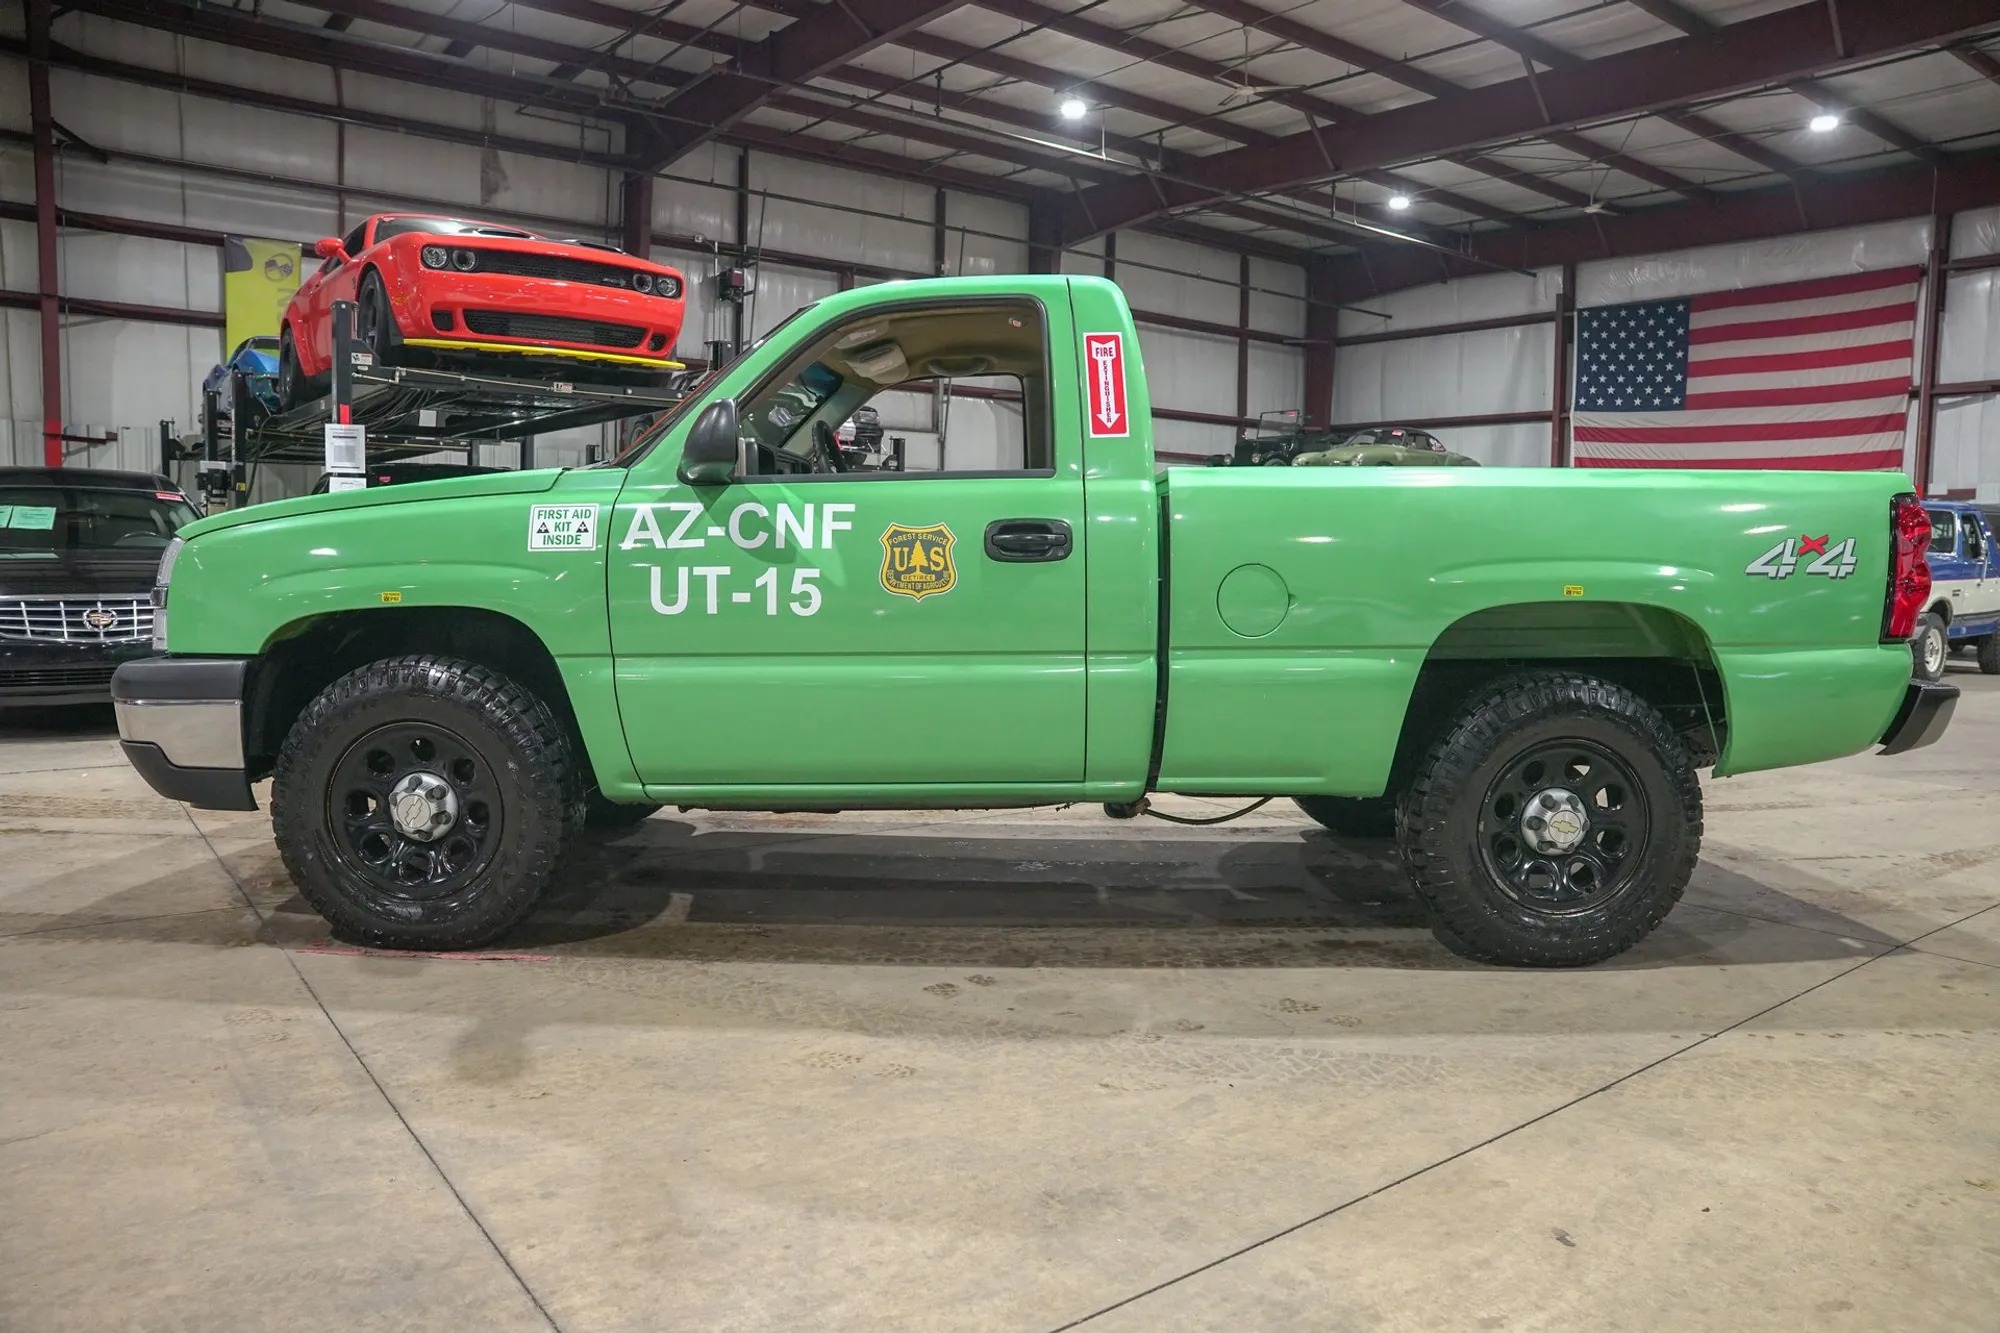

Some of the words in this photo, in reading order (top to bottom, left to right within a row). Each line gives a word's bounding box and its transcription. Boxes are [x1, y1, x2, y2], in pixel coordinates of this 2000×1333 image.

[1095, 347, 1114, 357] FIRE
[1102, 360, 1112, 423] EXTINGUISHER
[537, 509, 569, 520] FIRST
[571, 509, 592, 519] AID
[554, 521, 572, 532] KIT
[620, 502, 856, 550] AZ-CNF
[542, 534, 582, 545] INSIDE
[888, 533, 916, 545] FOREST
[917, 533, 949, 546] SERVICE
[650, 566, 822, 617] UT-15
